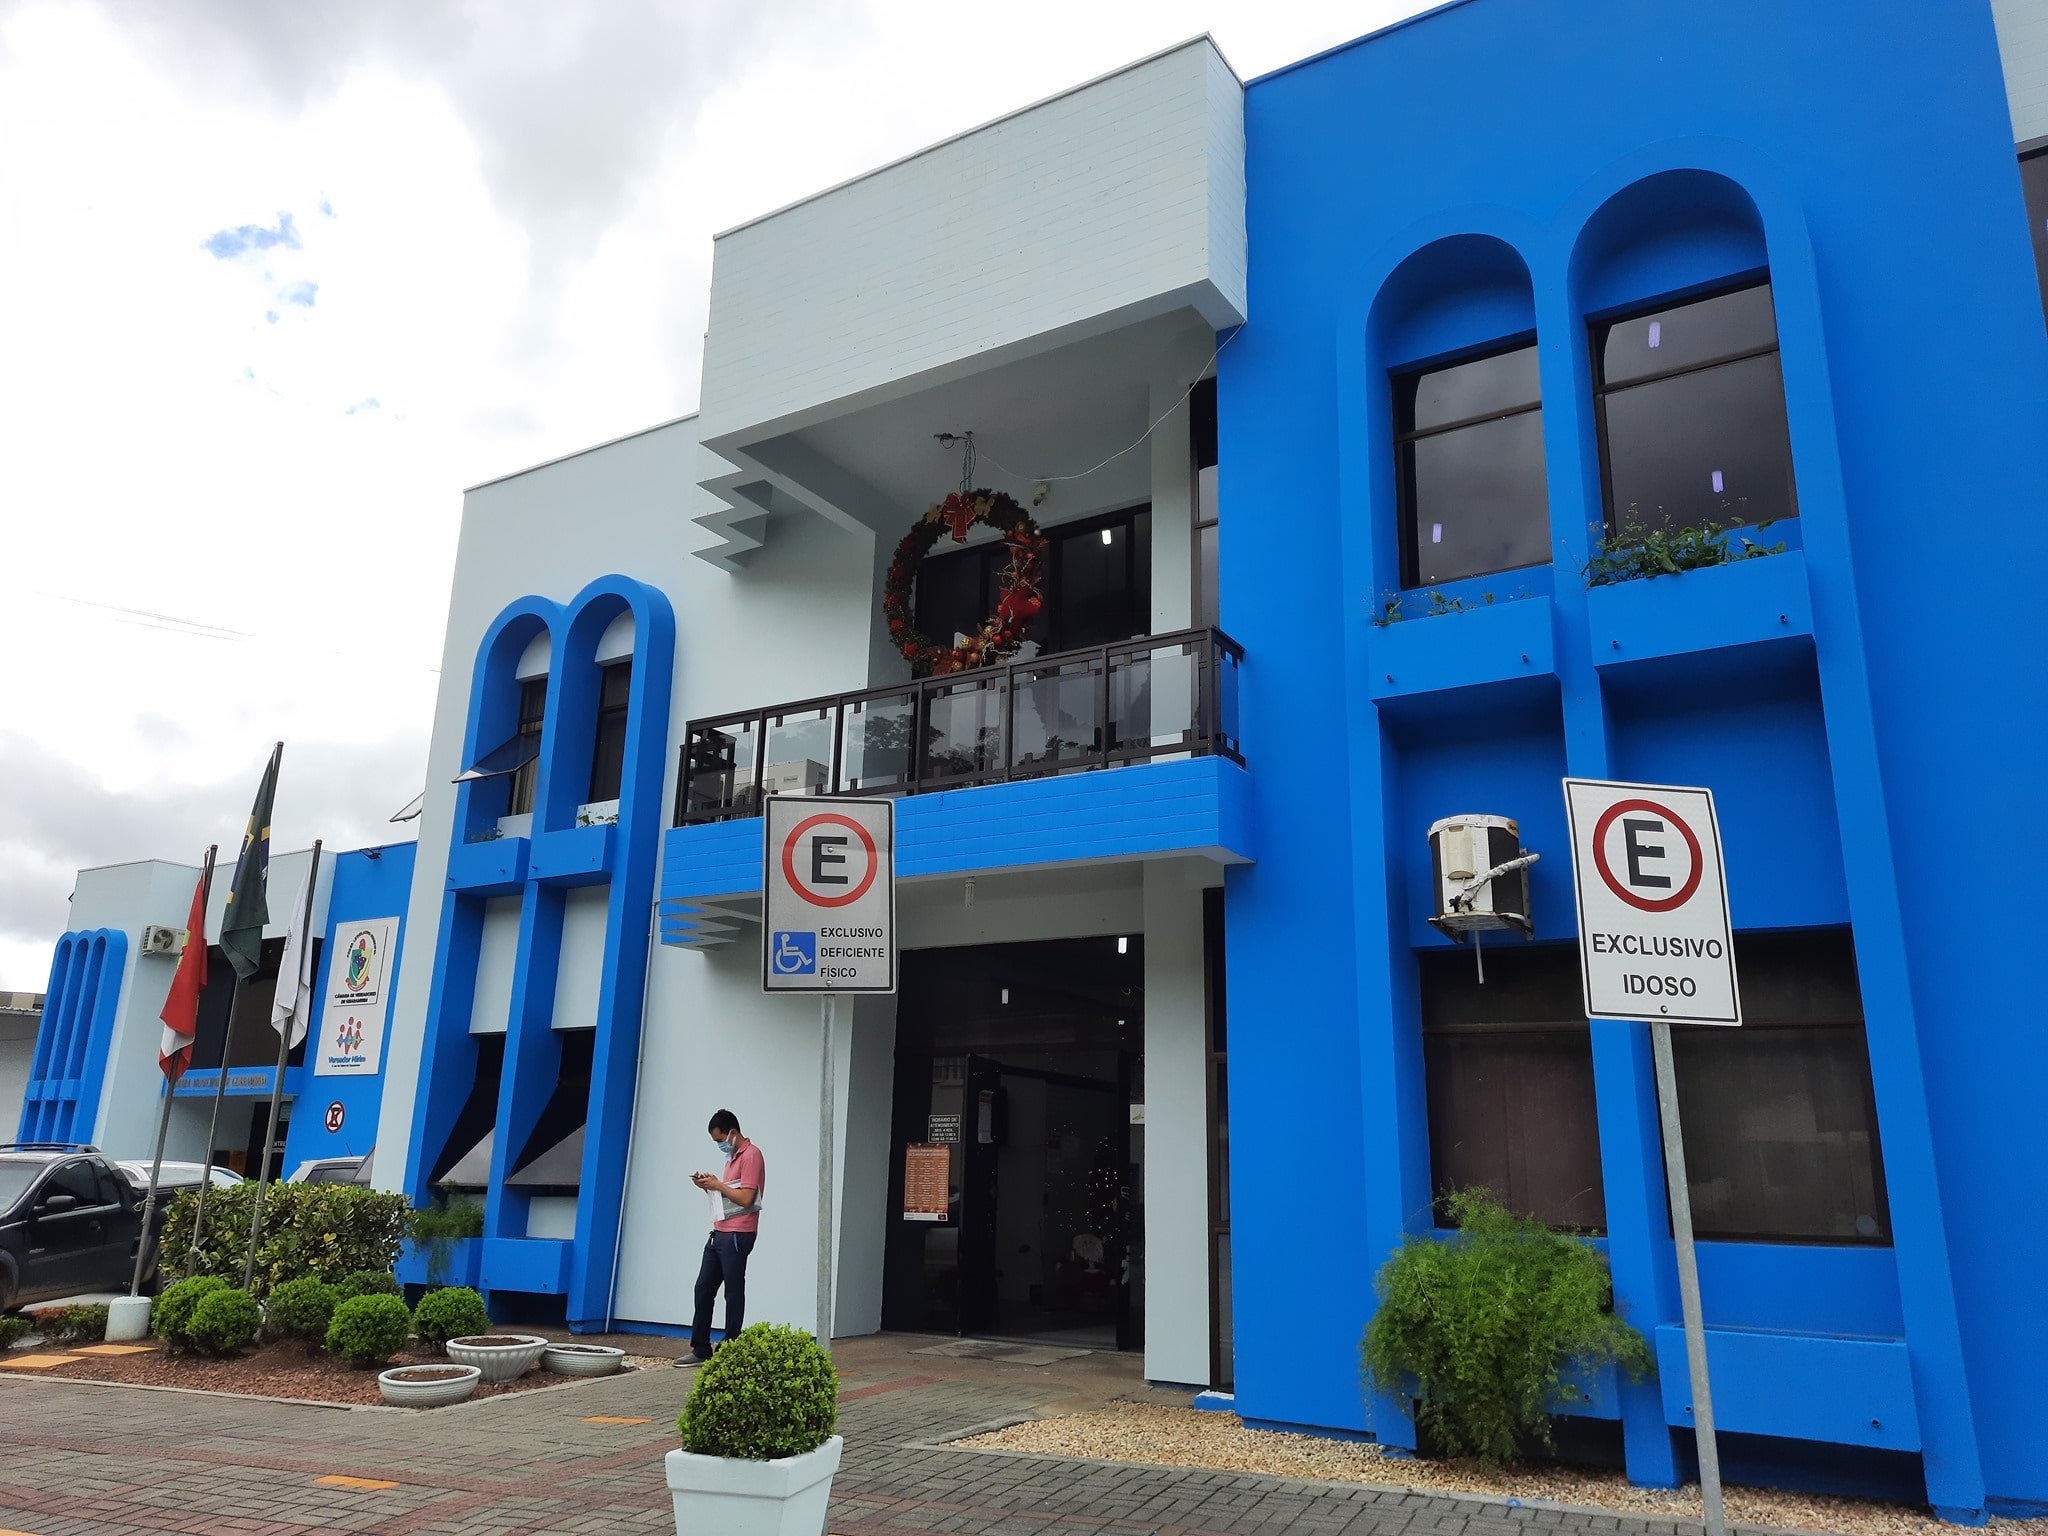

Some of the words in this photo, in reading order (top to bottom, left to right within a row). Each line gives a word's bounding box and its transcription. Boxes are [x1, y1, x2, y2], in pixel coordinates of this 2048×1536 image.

[812, 836, 848, 884] E
[1623, 818, 1671, 888] E
[820, 927, 883, 938] EXCLUSIVO
[820, 947, 885, 958] DEFICIENTE
[1592, 933, 1723, 959] EXCLUSIVO
[820, 965, 857, 978] FÍSICO
[1623, 974, 1696, 997] IDOSO
